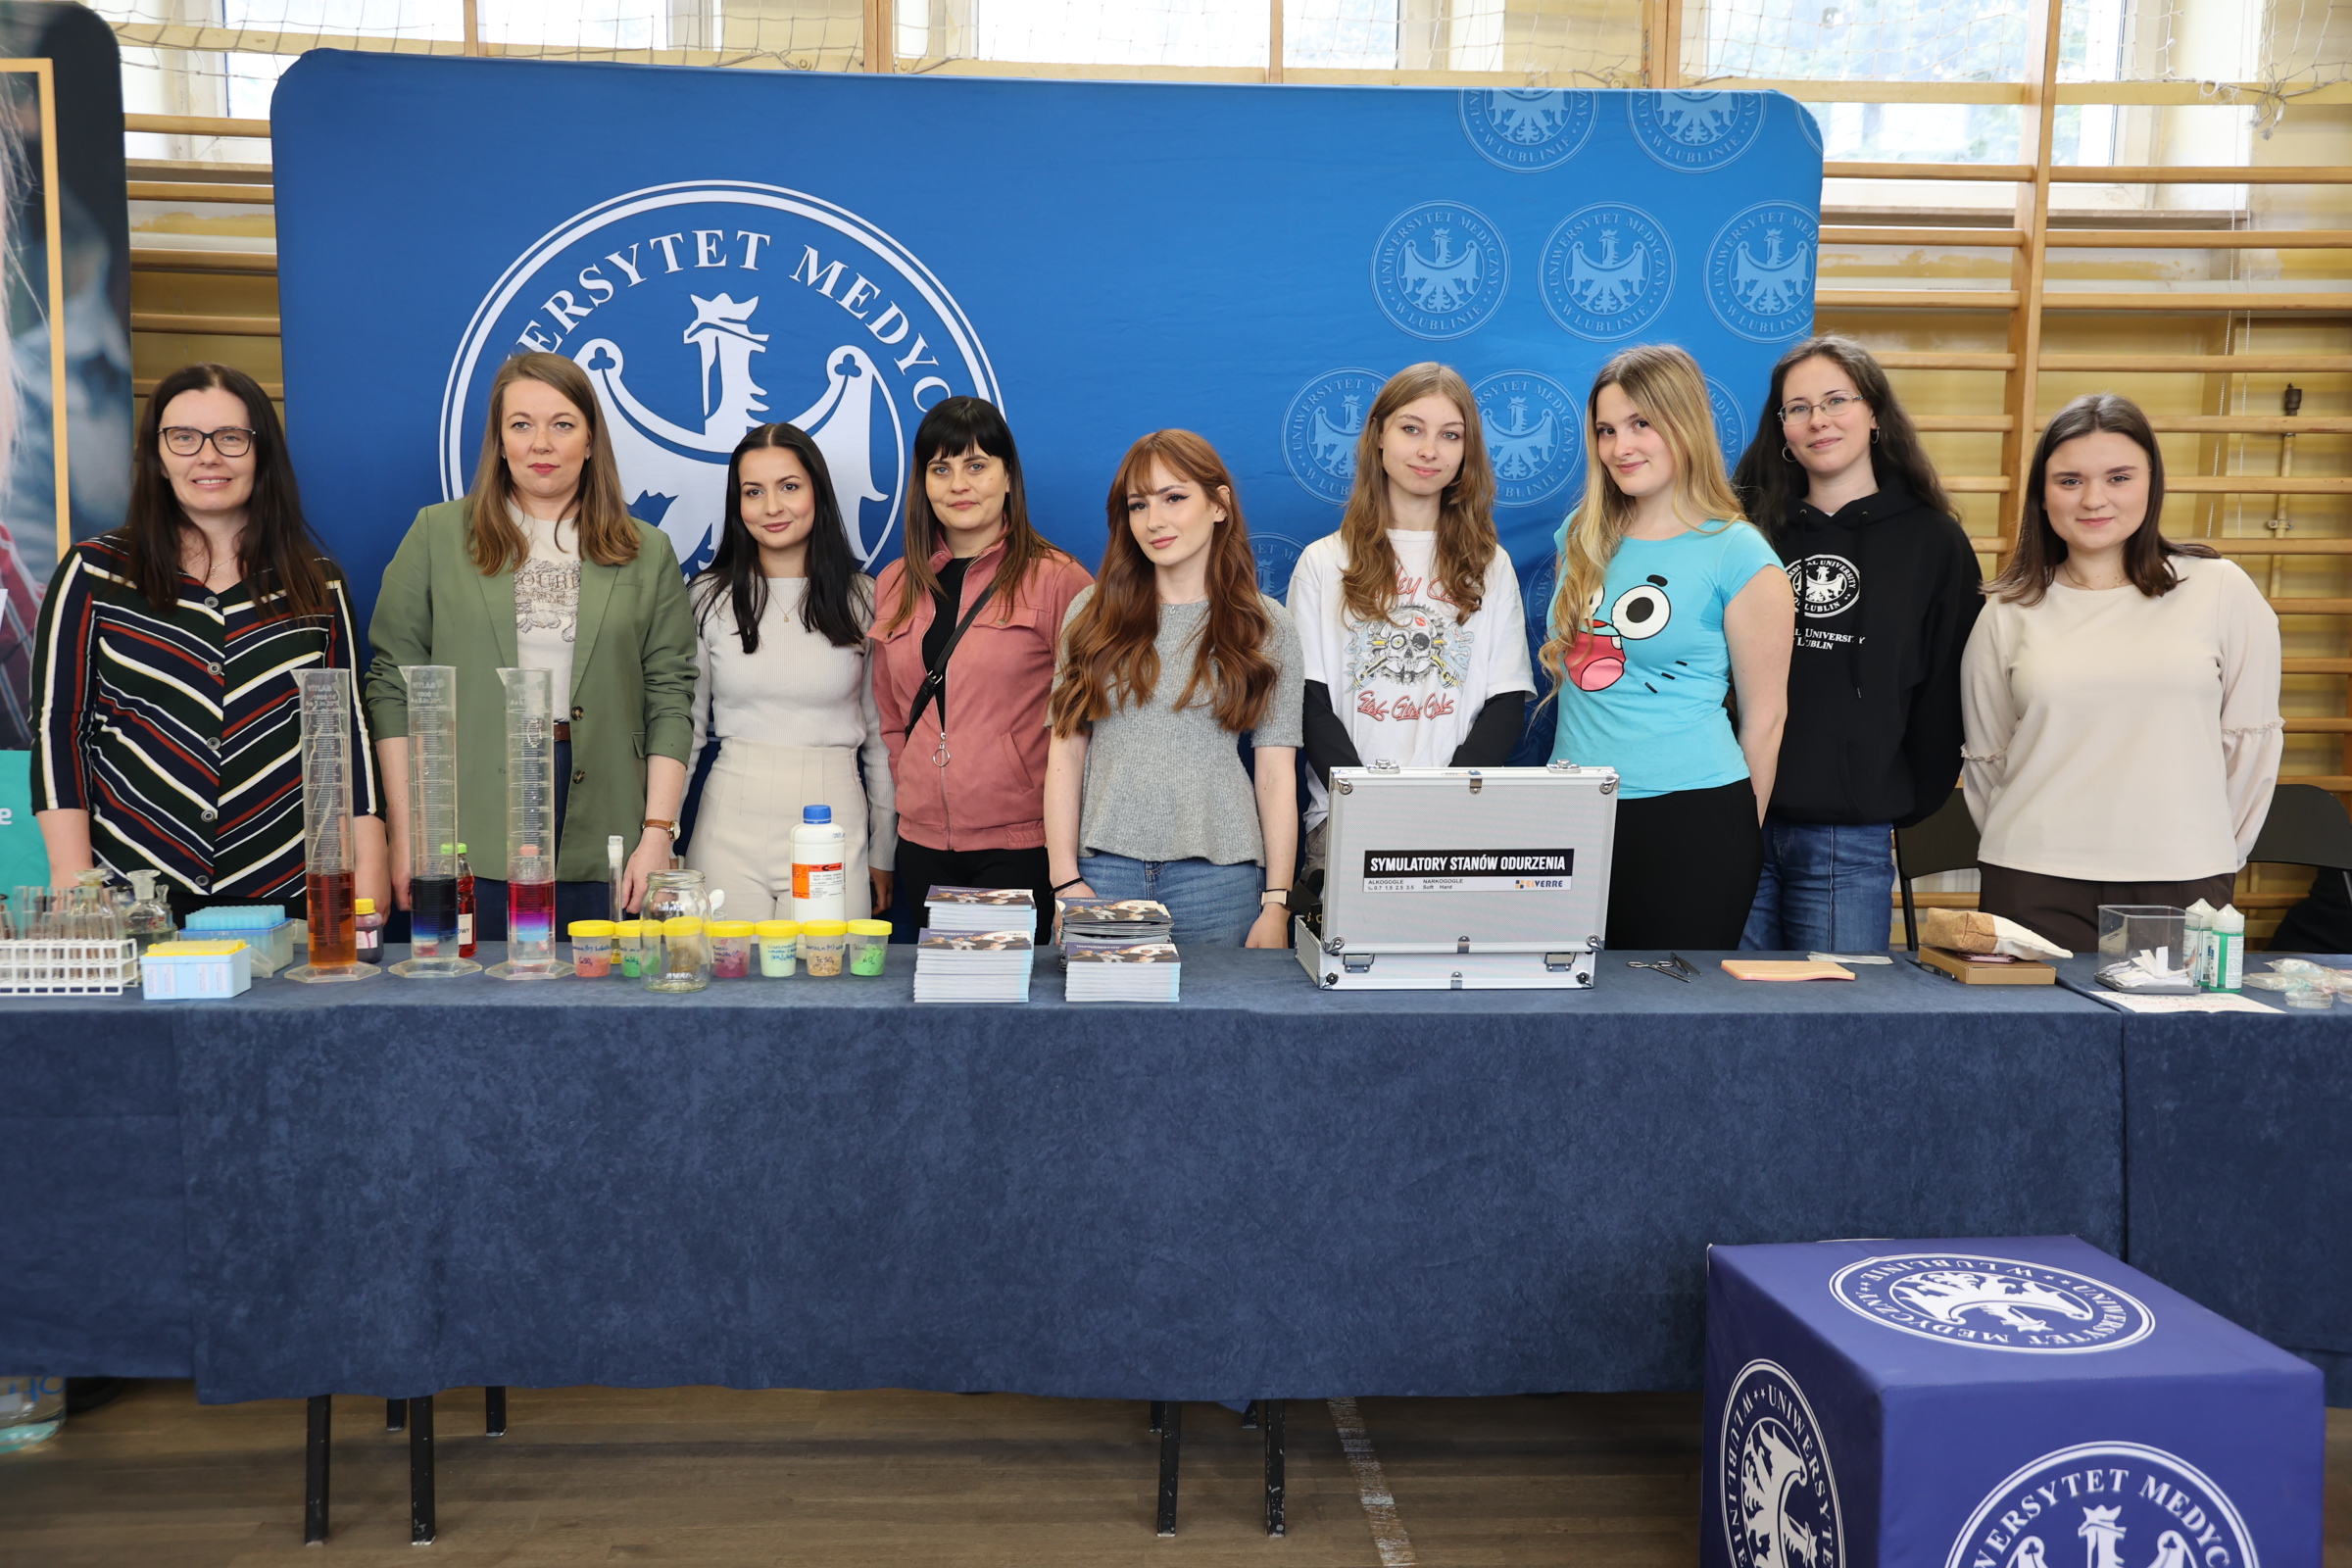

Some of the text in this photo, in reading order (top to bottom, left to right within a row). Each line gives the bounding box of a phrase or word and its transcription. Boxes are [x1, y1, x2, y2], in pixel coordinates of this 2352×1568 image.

[1484, 134, 1572, 163] W LUBLINIE
[1653, 135, 1741, 163] W LUBLINIE
[1382, 212, 1499, 288] UNIWERSYTET MEDYCZNY
[1548, 213, 1666, 289] UNIWERSYTET MEDYCZNY
[1715, 212, 1787, 288] UNIWERSYTET
[1396, 302, 1484, 330] W LUBLINIE
[1562, 304, 1648, 332] W LUBLINIE
[1727, 304, 1811, 333] W LUBLINIE
[1292, 378, 1364, 451] UNIWERSYTET
[1534, 384, 1574, 457] MEDYCZNY
[1305, 467, 1320, 480] W
[1819, 560, 1856, 589] UNIVERSITY
[1804, 602, 1840, 612] LUBLIN
[1370, 854, 1566, 871] SYMULATORY STANÓW ODURZENIA
[1860, 1258, 2033, 1282] W LUBLINIE
[1855, 1285, 2127, 1346] UNIWERSYTET MEDYCZNY
[1728, 1392, 1754, 1568] W LUBLINIE
